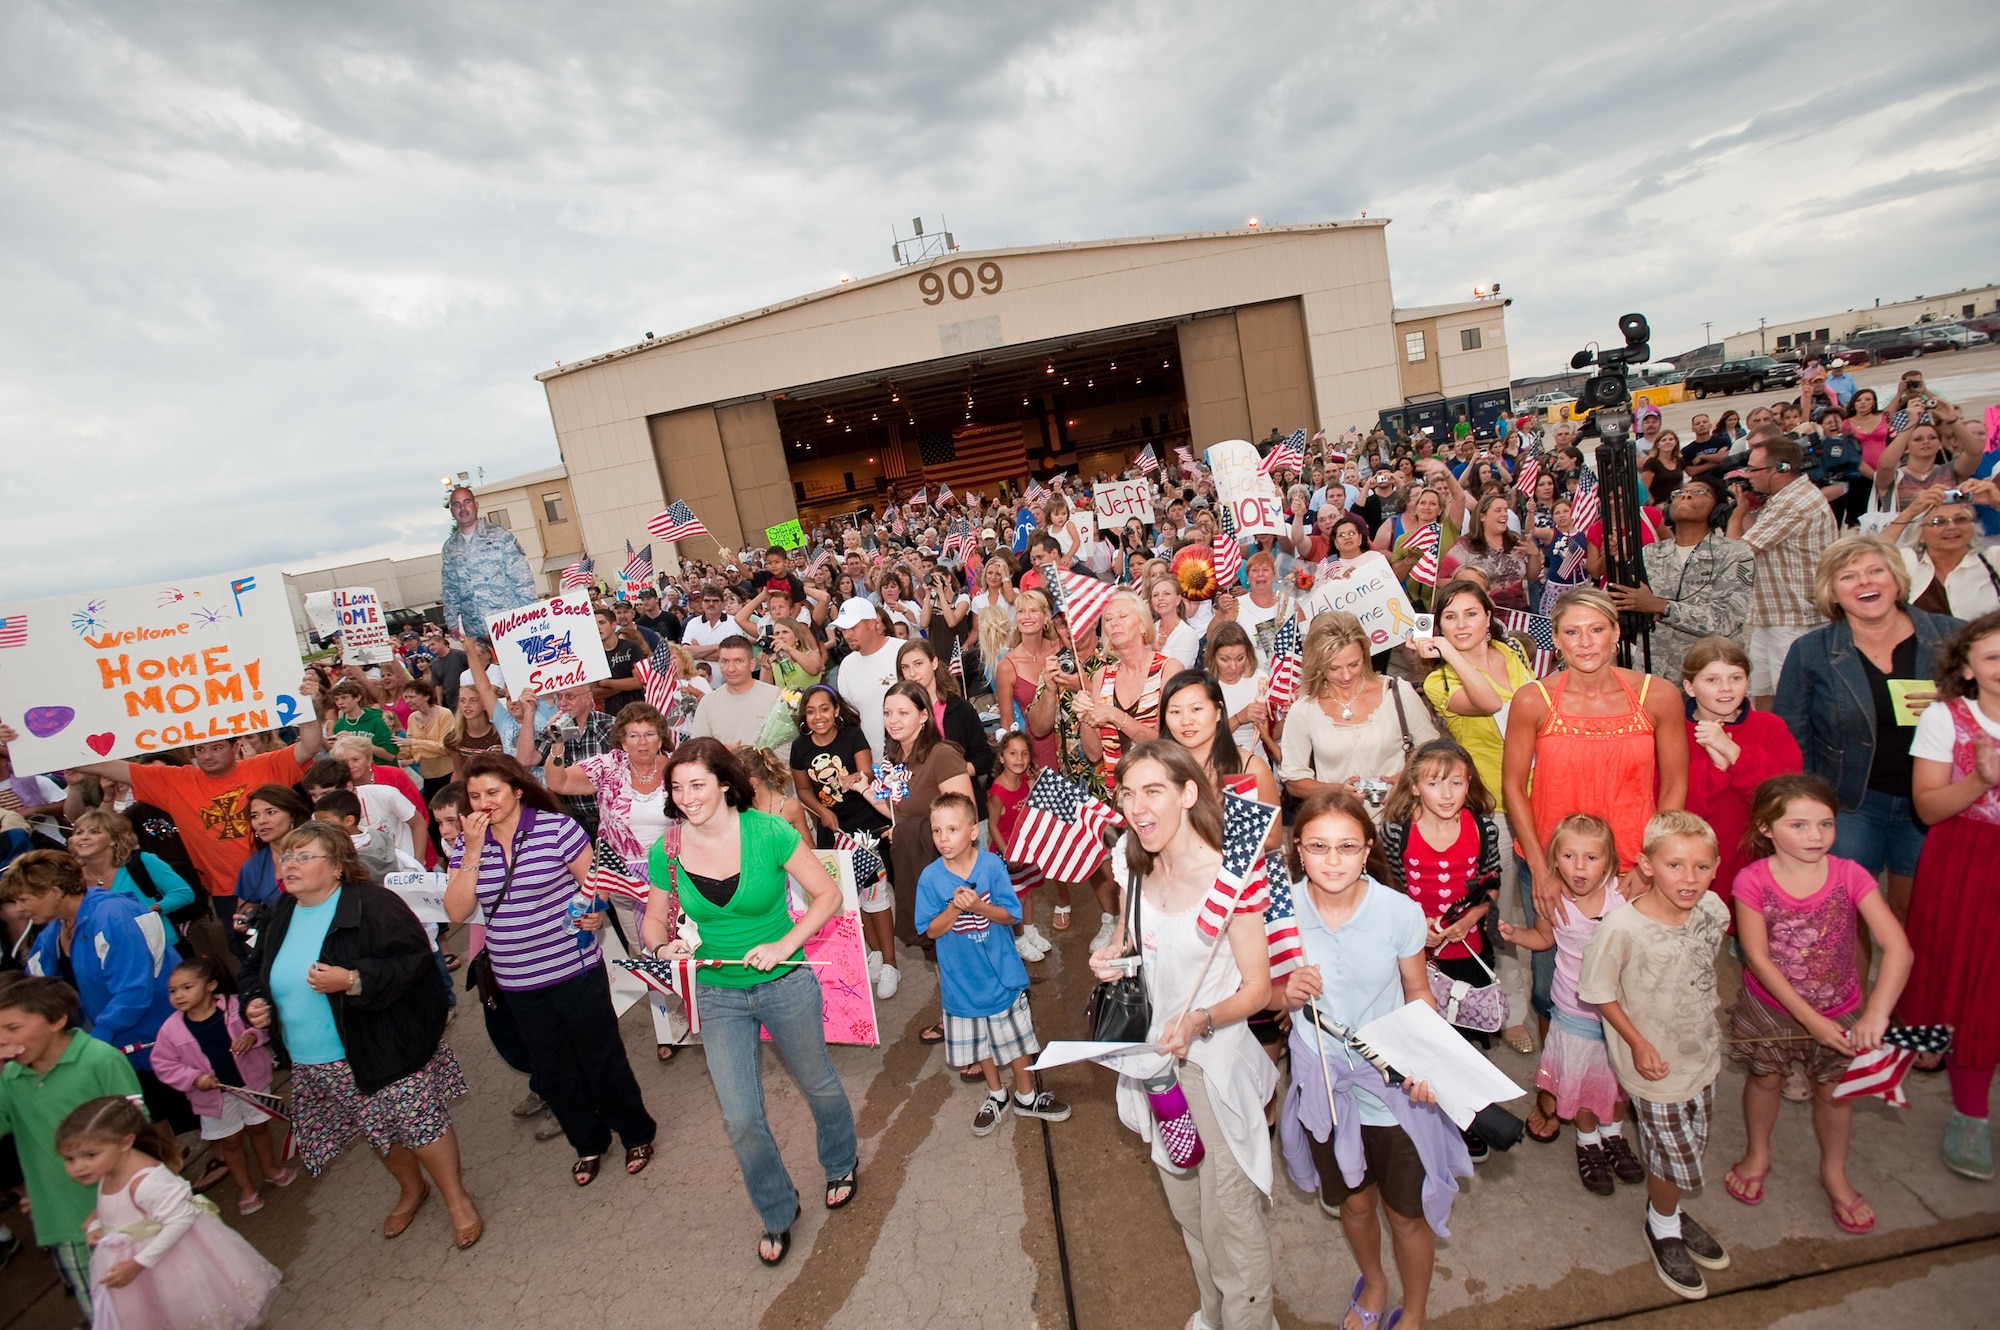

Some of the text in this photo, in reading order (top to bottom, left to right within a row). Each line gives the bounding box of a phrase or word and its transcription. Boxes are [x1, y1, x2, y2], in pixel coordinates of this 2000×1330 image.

[919, 262, 1003, 305] 909
[1096, 485, 1146, 517] Jeff
[1232, 498, 1275, 534] JOE
[336, 607, 378, 626] HOME
[491, 598, 591, 641] Welcome Back
[530, 620, 551, 634] to the
[1360, 606, 1384, 625] me
[84, 623, 190, 649] Welcome
[522, 629, 572, 665] USA
[96, 645, 233, 690] HOME
[529, 660, 587, 692] Sarah
[124, 658, 264, 717] MOM!
[135, 709, 270, 751] COLLIN
[387, 874, 424, 885] WELCOME
